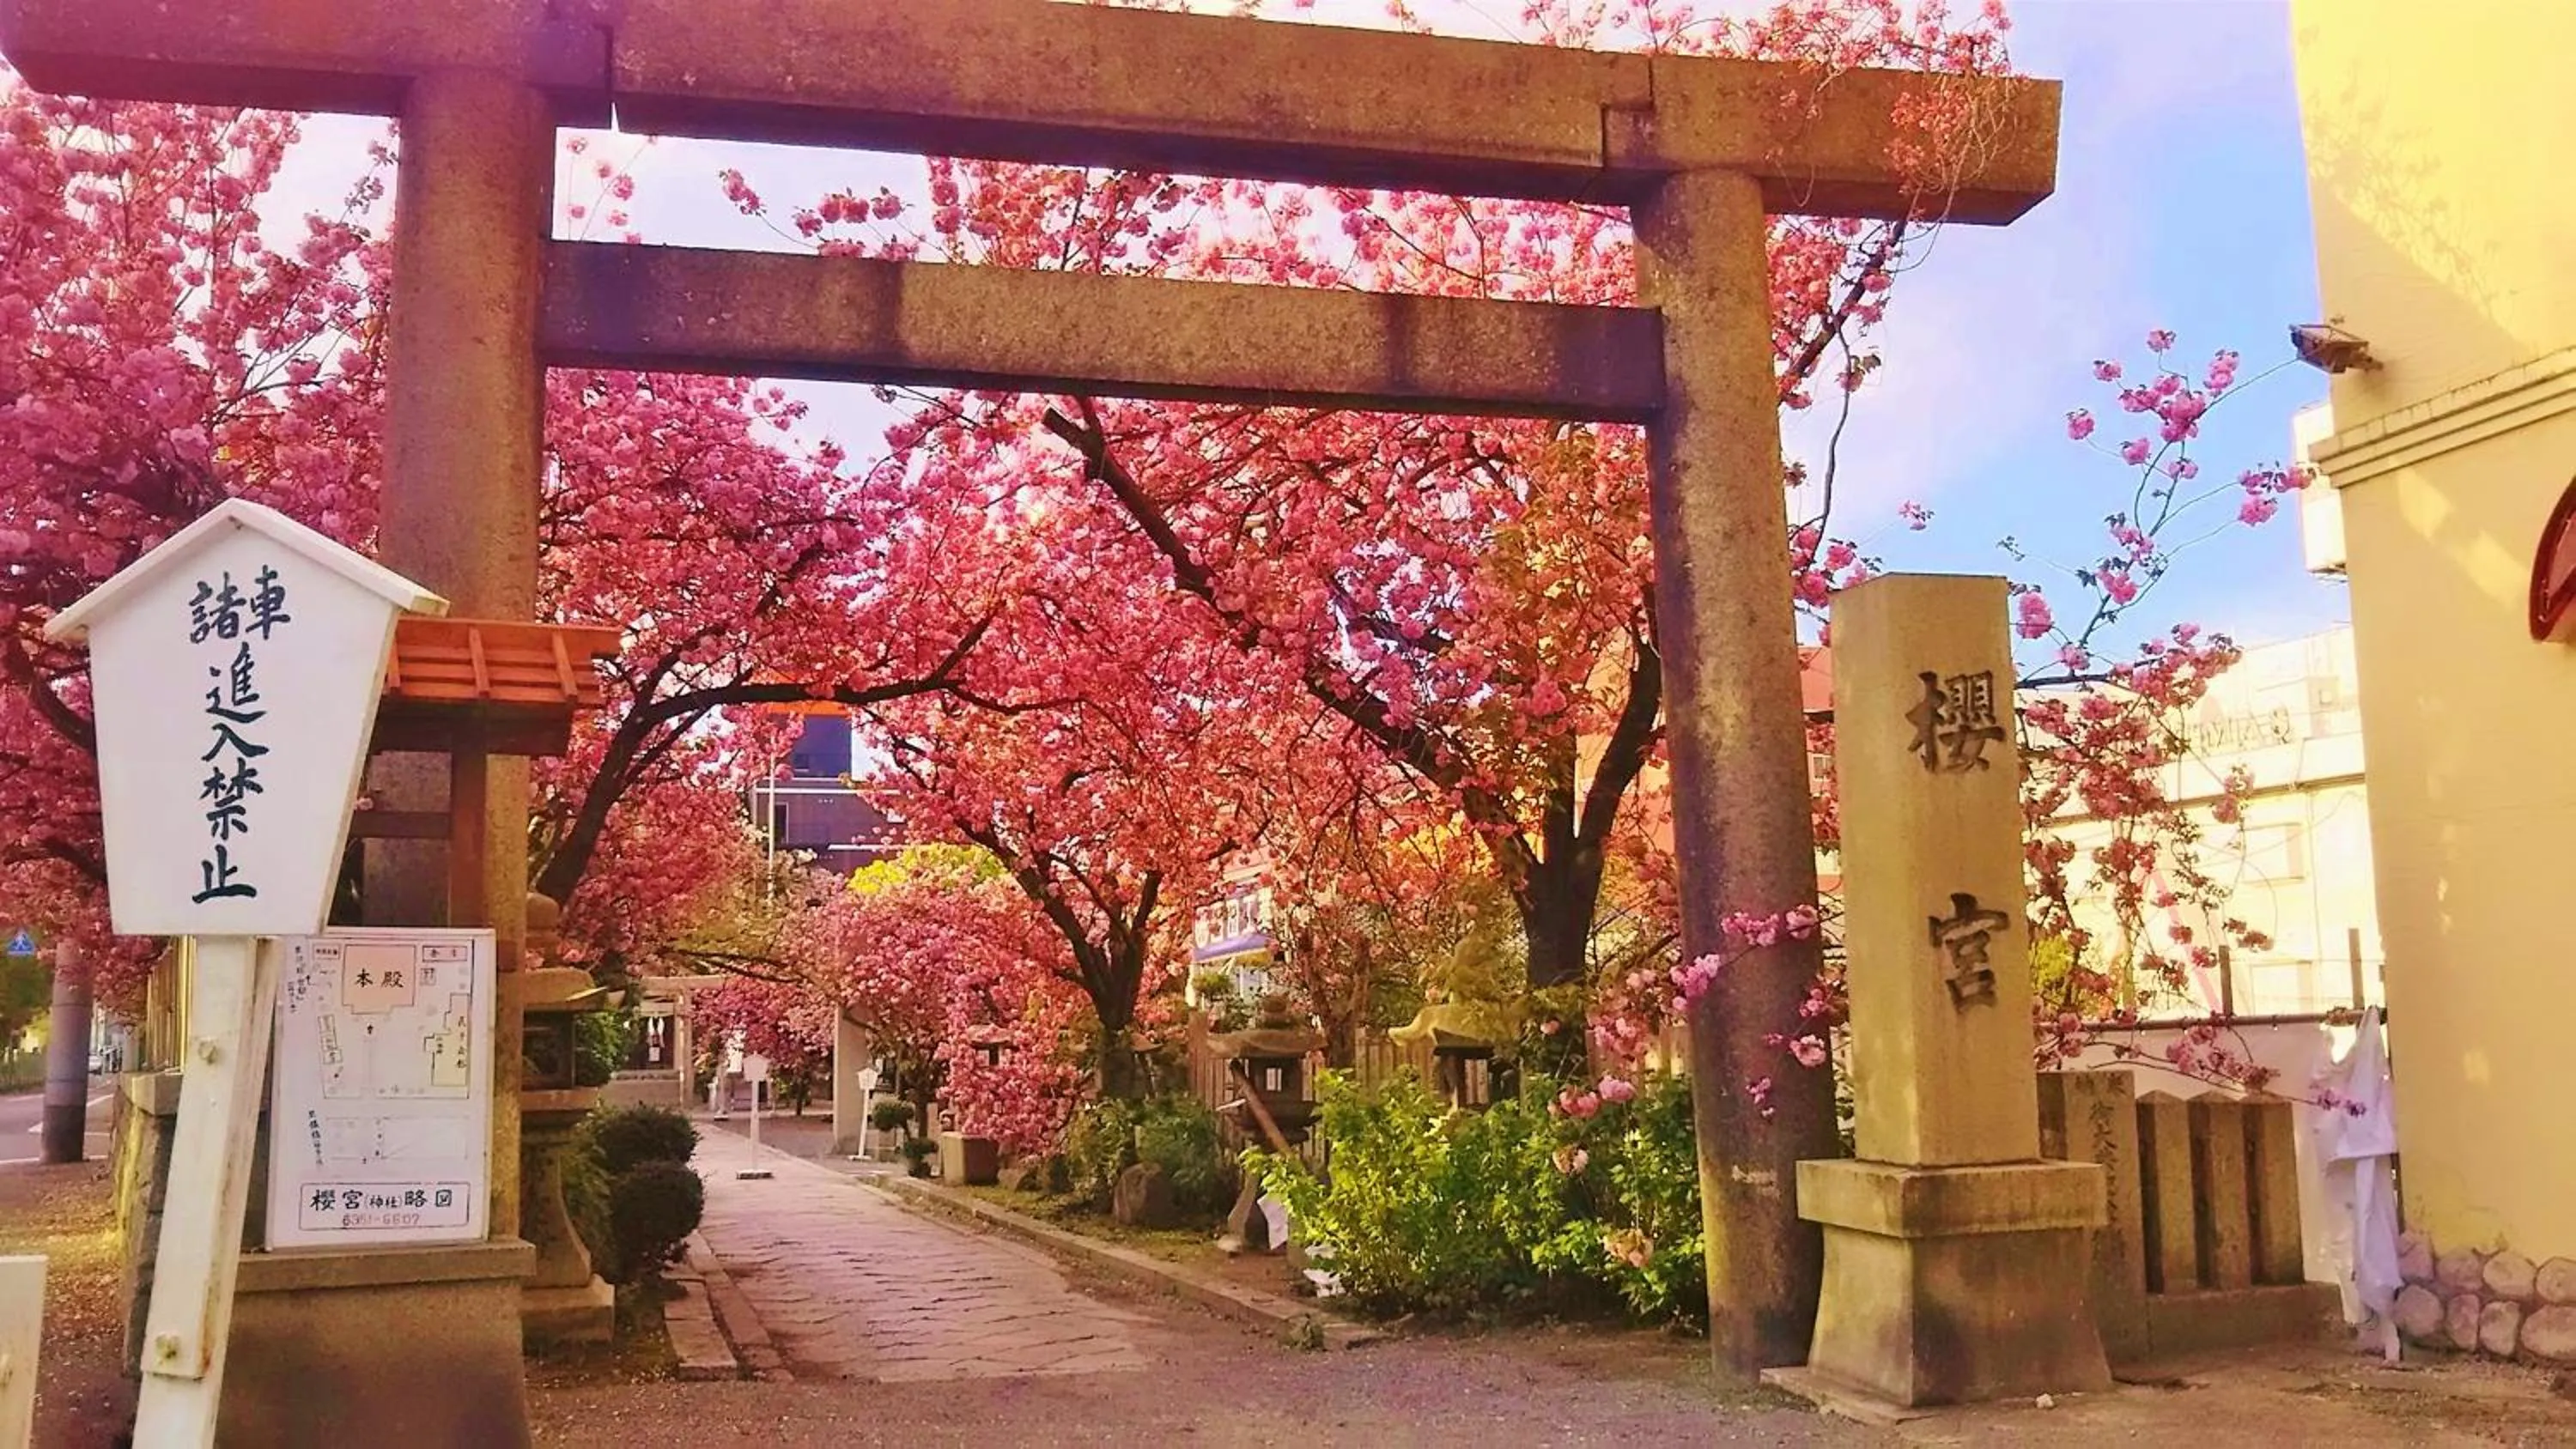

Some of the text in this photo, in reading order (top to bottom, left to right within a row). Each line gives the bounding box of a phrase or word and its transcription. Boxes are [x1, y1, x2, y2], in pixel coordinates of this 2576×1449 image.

[191, 642, 270, 904] 進入禁止
[355, 967, 405, 989] 本殿
